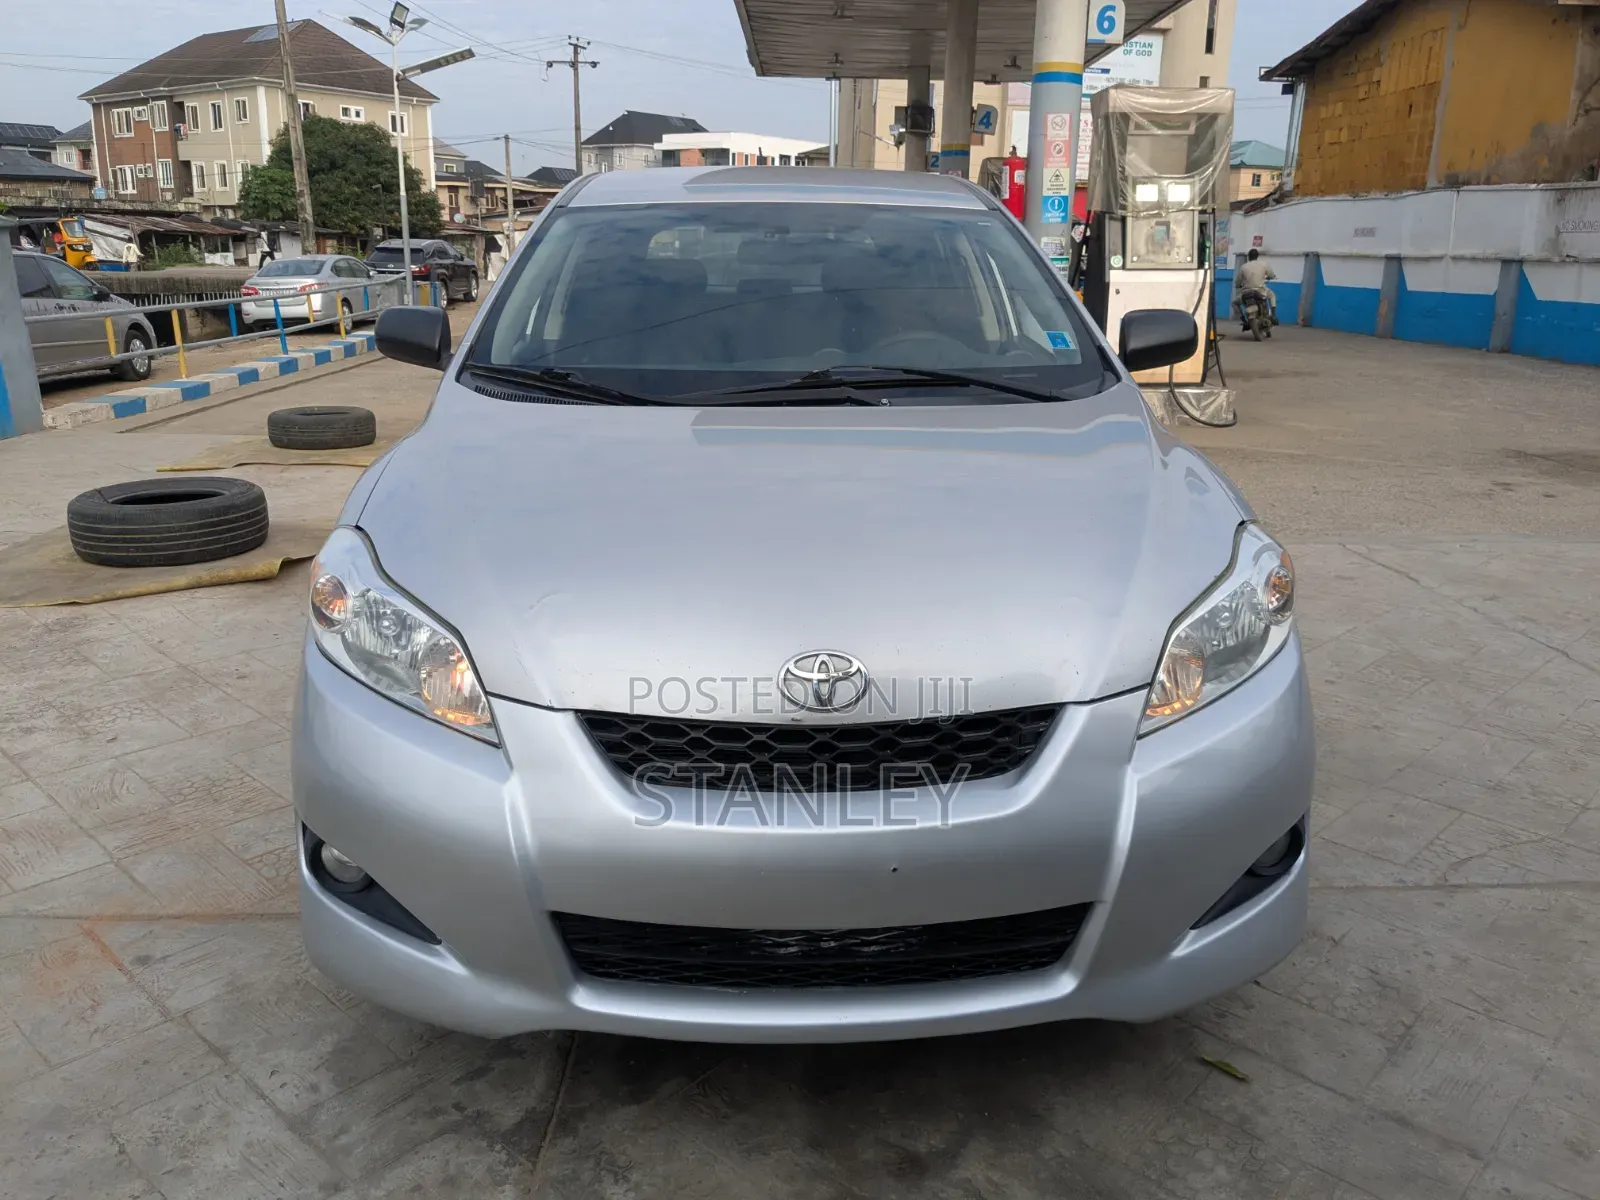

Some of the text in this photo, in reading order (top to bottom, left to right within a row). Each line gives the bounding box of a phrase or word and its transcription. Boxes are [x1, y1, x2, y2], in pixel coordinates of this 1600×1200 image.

[1096, 4, 1116, 35] 6
[1123, 41, 1153, 49] ISTIAN
[978, 111, 992, 129] 4
[930, 155, 939, 168] 2
